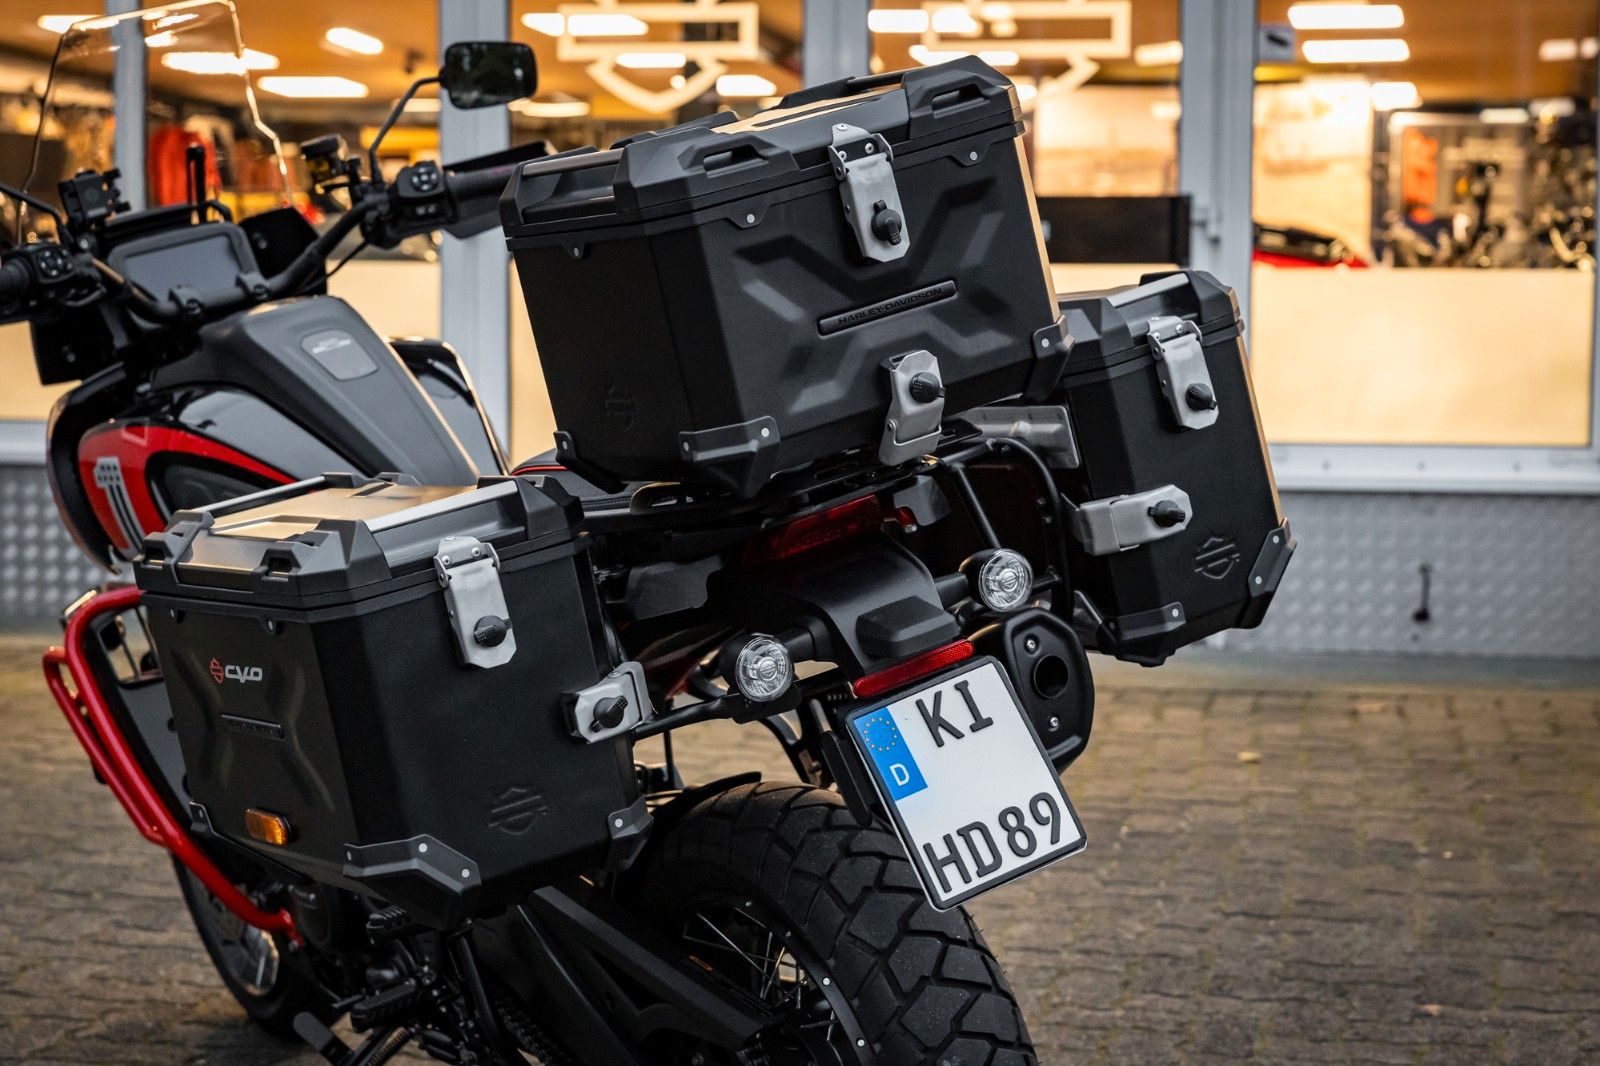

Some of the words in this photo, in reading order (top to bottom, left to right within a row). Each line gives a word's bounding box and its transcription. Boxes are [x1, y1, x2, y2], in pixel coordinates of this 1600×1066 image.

[838, 287, 942, 324] HARLEY-DAVIDSON
[225, 665, 263, 683] CVO
[915, 679, 993, 748] KI
[890, 763, 910, 787] D
